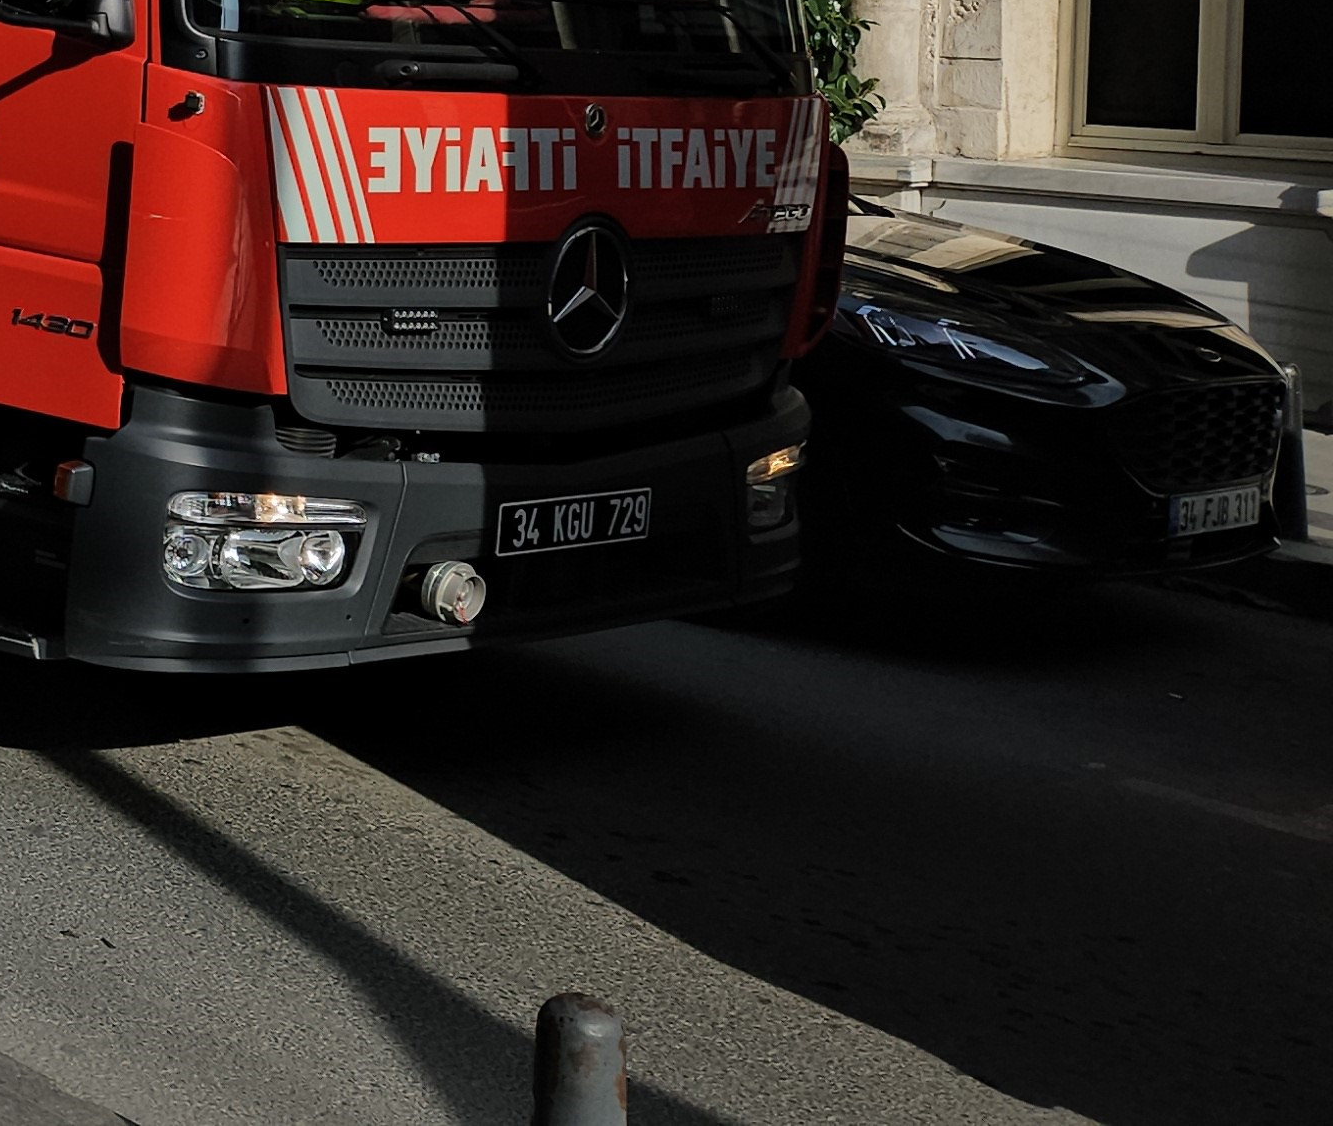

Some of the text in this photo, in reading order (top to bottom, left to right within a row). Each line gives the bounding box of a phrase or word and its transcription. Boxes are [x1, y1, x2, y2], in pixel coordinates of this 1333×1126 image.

[618, 127, 776, 191] İTFAİYE
[11, 306, 96, 340] 1430
[513, 495, 648, 549] 34 KGU 729
[1181, 490, 1257, 531] 34 FJB 311
